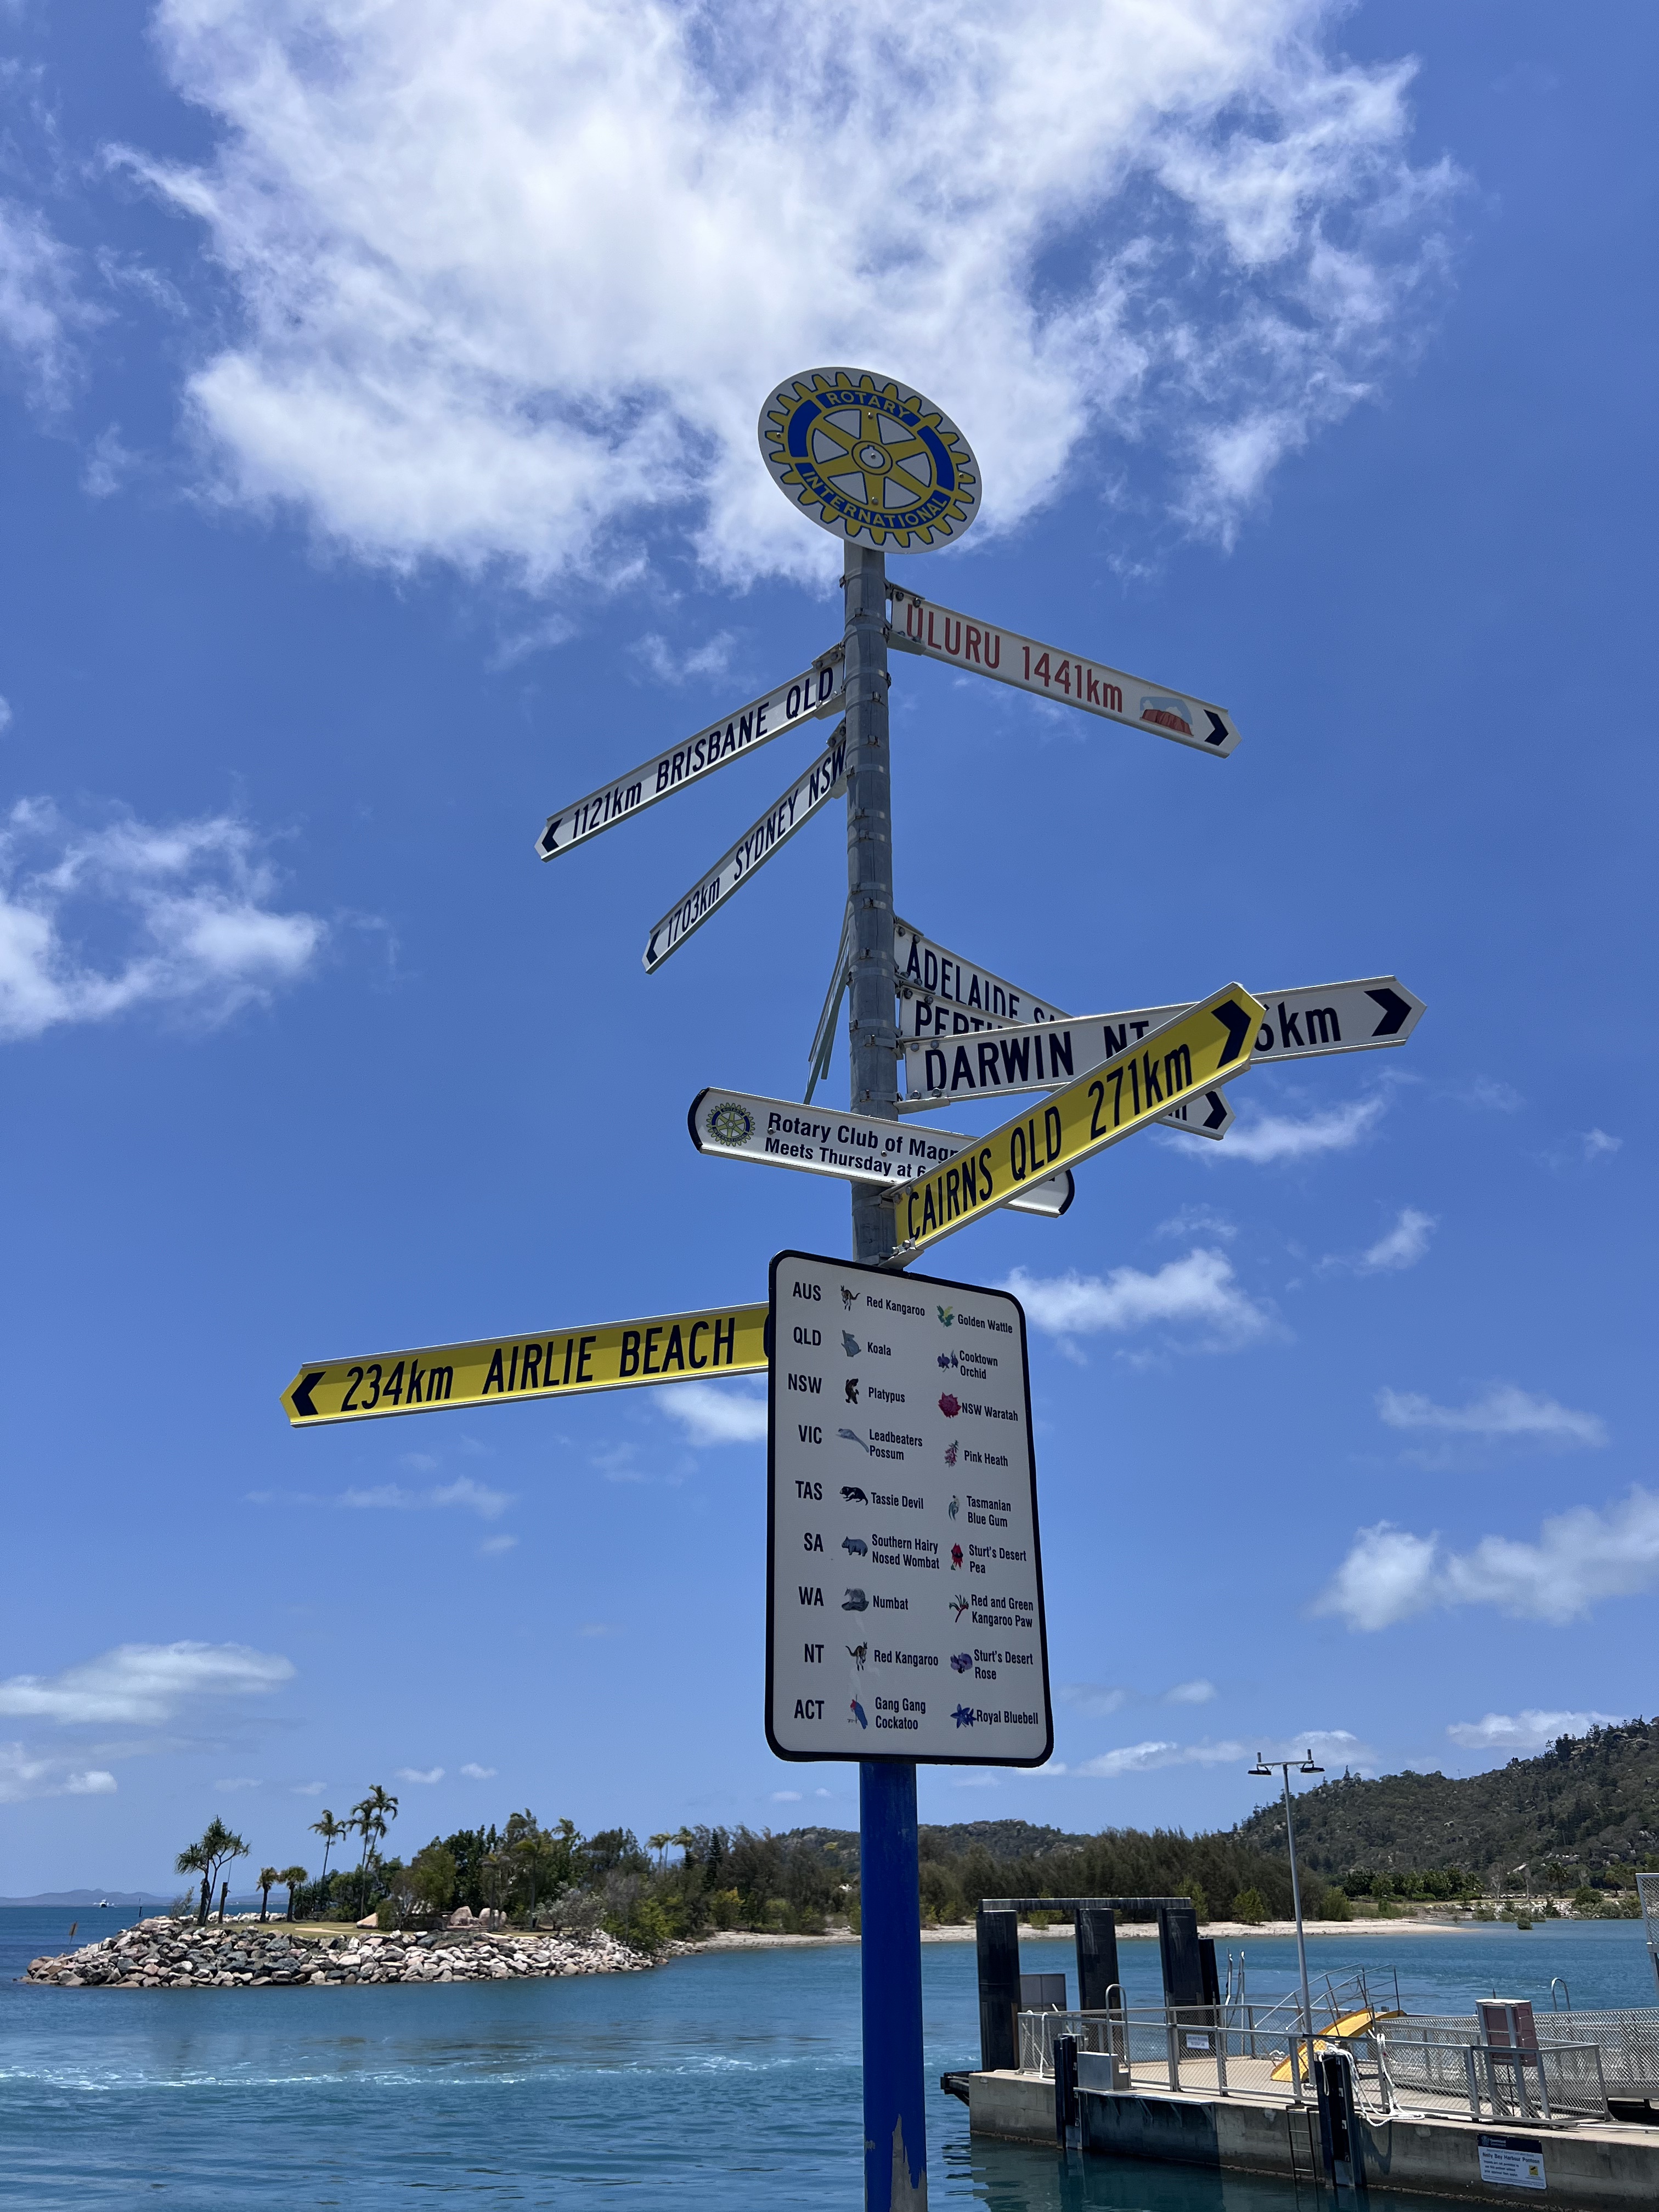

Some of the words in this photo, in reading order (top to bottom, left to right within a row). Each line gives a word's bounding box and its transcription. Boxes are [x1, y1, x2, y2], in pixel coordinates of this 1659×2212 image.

[826, 391, 911, 419] ROTARY
[803, 471, 947, 527] INTERNATIONAL
[906, 604, 1000, 669] ULURU
[1023, 646, 1122, 713] 1441km
[573, 782, 641, 839] 1121km
[656, 702, 769, 793] BRISBANE
[786, 668, 833, 719] QLD
[668, 877, 720, 947] 1703km
[734, 791, 799, 881] SYDNEY
[809, 740, 846, 808] NSW
[925, 1031, 1074, 1091] DARWIN
[768, 1113, 831, 1143] Rotary
[838, 1126, 878, 1148] Club
[885, 1137, 902, 1153] of
[907, 1148, 993, 1240] CAIRNS
[1011, 1107, 1061, 1181] QLD
[1088, 1043, 1192, 1140] 271km
[765, 1137, 813, 1159] Meets
[820, 1147, 891, 1176] Thursday
[898, 1164, 911, 1177] at
[793, 1282, 821, 1301] AUS
[867, 1296, 883, 1308] Red
[886, 1300, 924, 1316] Kangaroo
[958, 1314, 985, 1328] Golden
[988, 1319, 1012, 1333] Wattle
[794, 1327, 821, 1346] QLD
[868, 1342, 891, 1356] Koala
[960, 1350, 997, 1366] Cooktown
[341, 1358, 454, 1412] 234km
[482, 1335, 597, 1394] AIRLIE
[620, 1318, 735, 1378] BEACH
[961, 1365, 986, 1379] Orchid
[788, 1373, 822, 1393] NSW
[869, 1387, 905, 1403] Platypus
[962, 1403, 981, 1415] NSW
[984, 1406, 1018, 1421] Waratah
[798, 1425, 822, 1444] VIC
[870, 1429, 922, 1446] Leadbeaters
[870, 1445, 904, 1460] Possum
[964, 1450, 982, 1463] Pink
[985, 1453, 1008, 1466] Heath
[795, 1481, 822, 1500] TAS
[871, 1492, 899, 1506] Tassie
[902, 1496, 923, 1509] Devil
[967, 1496, 1011, 1511] Tasmanian
[968, 1512, 986, 1525] Blue
[989, 1515, 1007, 1527] Gum
[804, 1533, 823, 1551] SA
[872, 1534, 911, 1549] Southern
[915, 1538, 938, 1554] Hairy
[873, 1551, 900, 1565] Nosed
[903, 1554, 939, 1569] Wombat
[969, 1544, 996, 1558] Sturt's
[1000, 1548, 1026, 1561] Desert
[970, 1561, 985, 1573] Pea
[799, 1587, 823, 1606] WA
[873, 1595, 908, 1610] Numbat
[972, 1594, 988, 1606] Red
[991, 1598, 1006, 1608] and
[1009, 1598, 1033, 1611] Green
[972, 1611, 1012, 1627] Kangaroo
[1015, 1615, 1032, 1627] Paw
[805, 1644, 824, 1663] NT
[874, 1650, 892, 1662] Red
[895, 1651, 938, 1667] Kangaroo
[974, 1649, 1002, 1662] Sturt's
[1006, 1651, 1033, 1664] Desert
[975, 1667, 996, 1679] Rose
[794, 1700, 825, 1719] ACT
[876, 1697, 899, 1713] Gang
[902, 1699, 926, 1714] Gang
[876, 1716, 918, 1729] Cockatoo
[977, 1710, 1001, 1724] Royal
[1004, 1711, 1038, 1724] Bluebell
